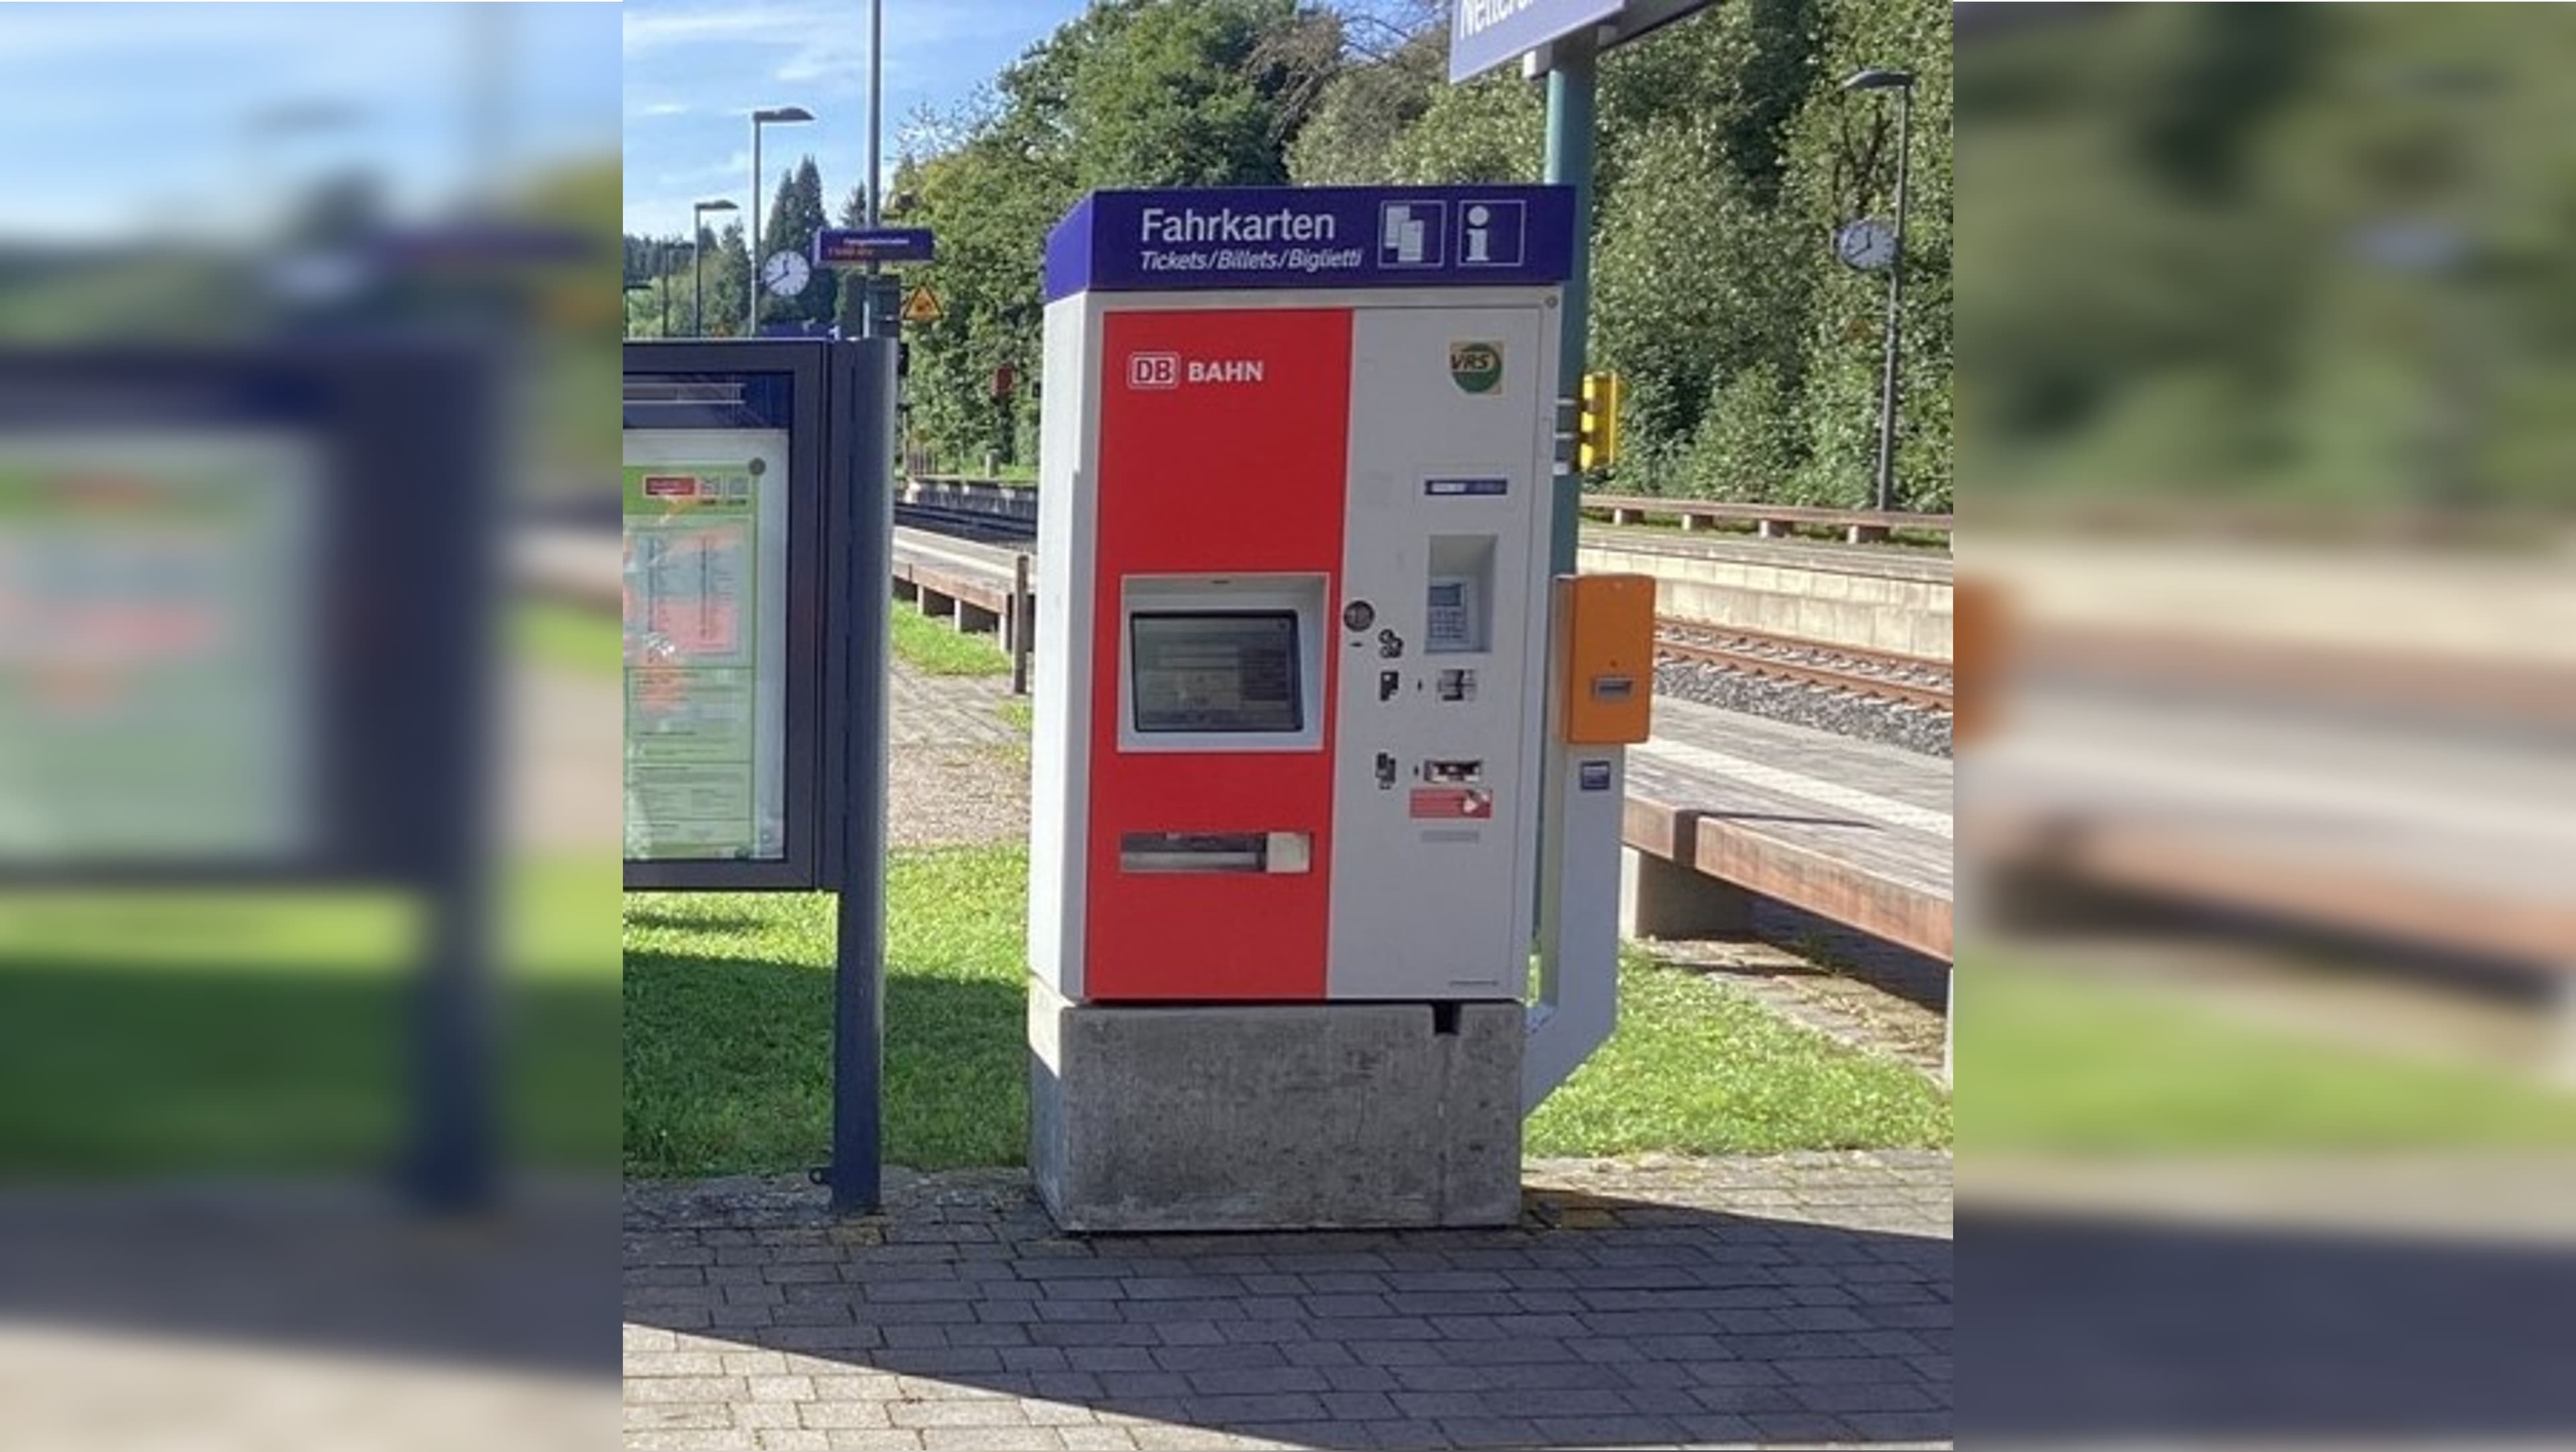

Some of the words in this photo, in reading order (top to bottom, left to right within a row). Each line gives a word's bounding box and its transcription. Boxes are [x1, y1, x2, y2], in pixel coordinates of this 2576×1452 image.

[1142, 208, 1336, 242] Fahrkarten
[1136, 359, 1171, 381] DB
[1188, 361, 1263, 382] BAHN
[1450, 353, 1489, 370] VRS
